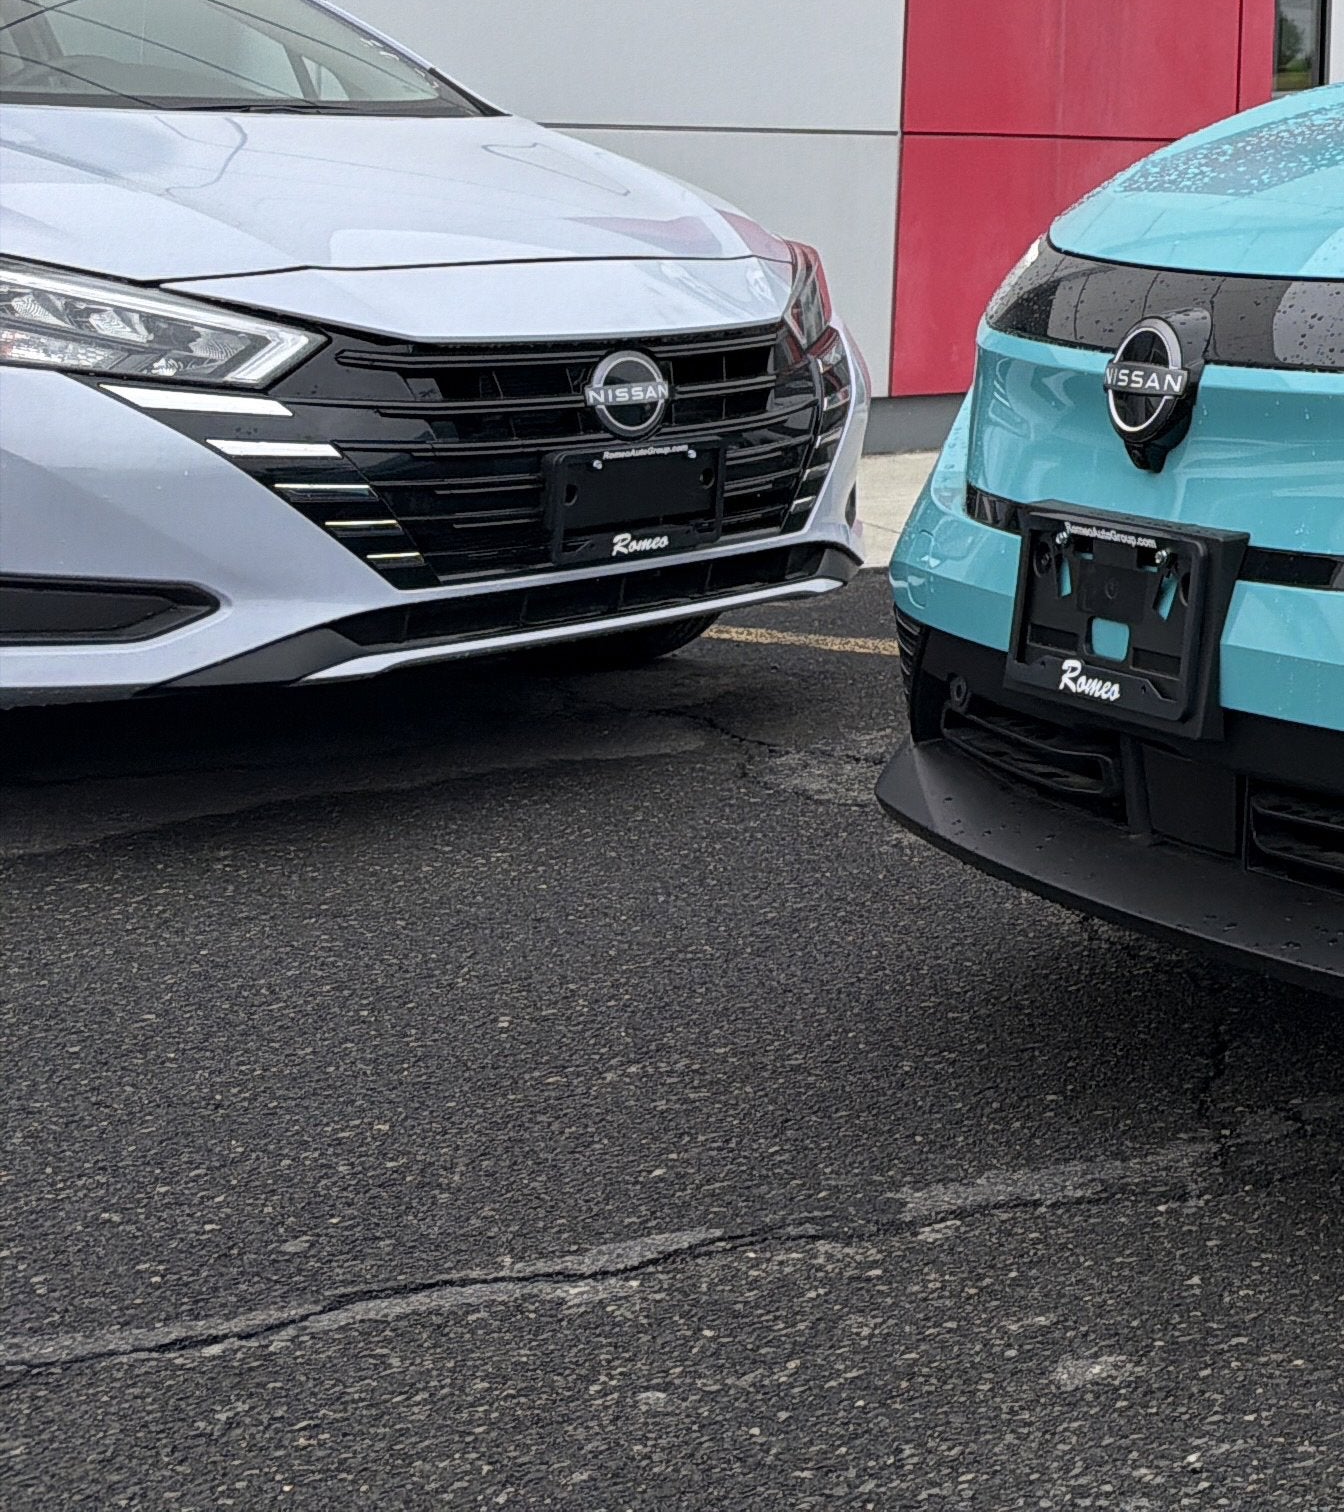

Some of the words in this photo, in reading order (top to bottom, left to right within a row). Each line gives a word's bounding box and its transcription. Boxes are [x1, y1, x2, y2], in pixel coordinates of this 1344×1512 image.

[1104, 367, 1182, 393] NISSAN
[588, 382, 668, 404] NISSAN
[603, 444, 689, 461] RomeoAutoGroup.com
[611, 532, 670, 557] Romeo
[1064, 521, 1157, 549] RomeoAutoGroup.com
[1058, 659, 1120, 701] Romeo
